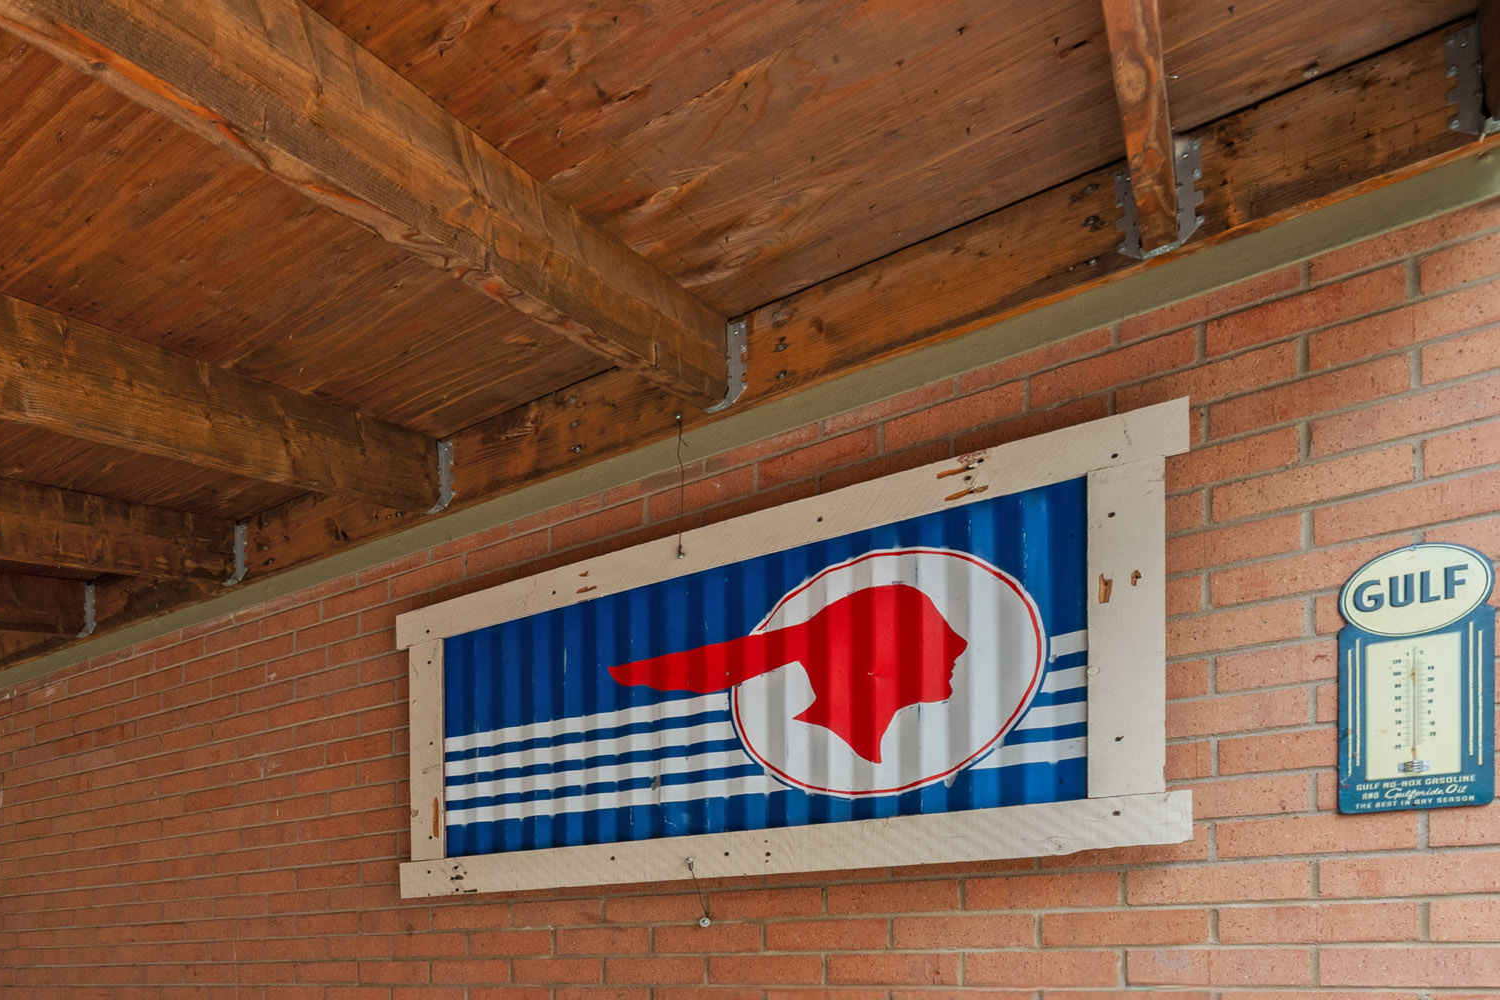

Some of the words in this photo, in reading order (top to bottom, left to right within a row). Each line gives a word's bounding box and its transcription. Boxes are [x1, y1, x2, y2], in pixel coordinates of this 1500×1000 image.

[1353, 564, 1468, 612] GULF
[1356, 782, 1379, 791] GULF
[1383, 779, 1422, 789] NO-NOX
[1425, 774, 1476, 785] GASOLINE
[1362, 792, 1379, 800] AND
[1385, 787, 1445, 800] Gulfpride
[1445, 784, 1467, 794] Oil
[1355, 802, 1372, 810] THE
[1375, 800, 1397, 808] BEST
[1436, 795, 1475, 804] SEASON
